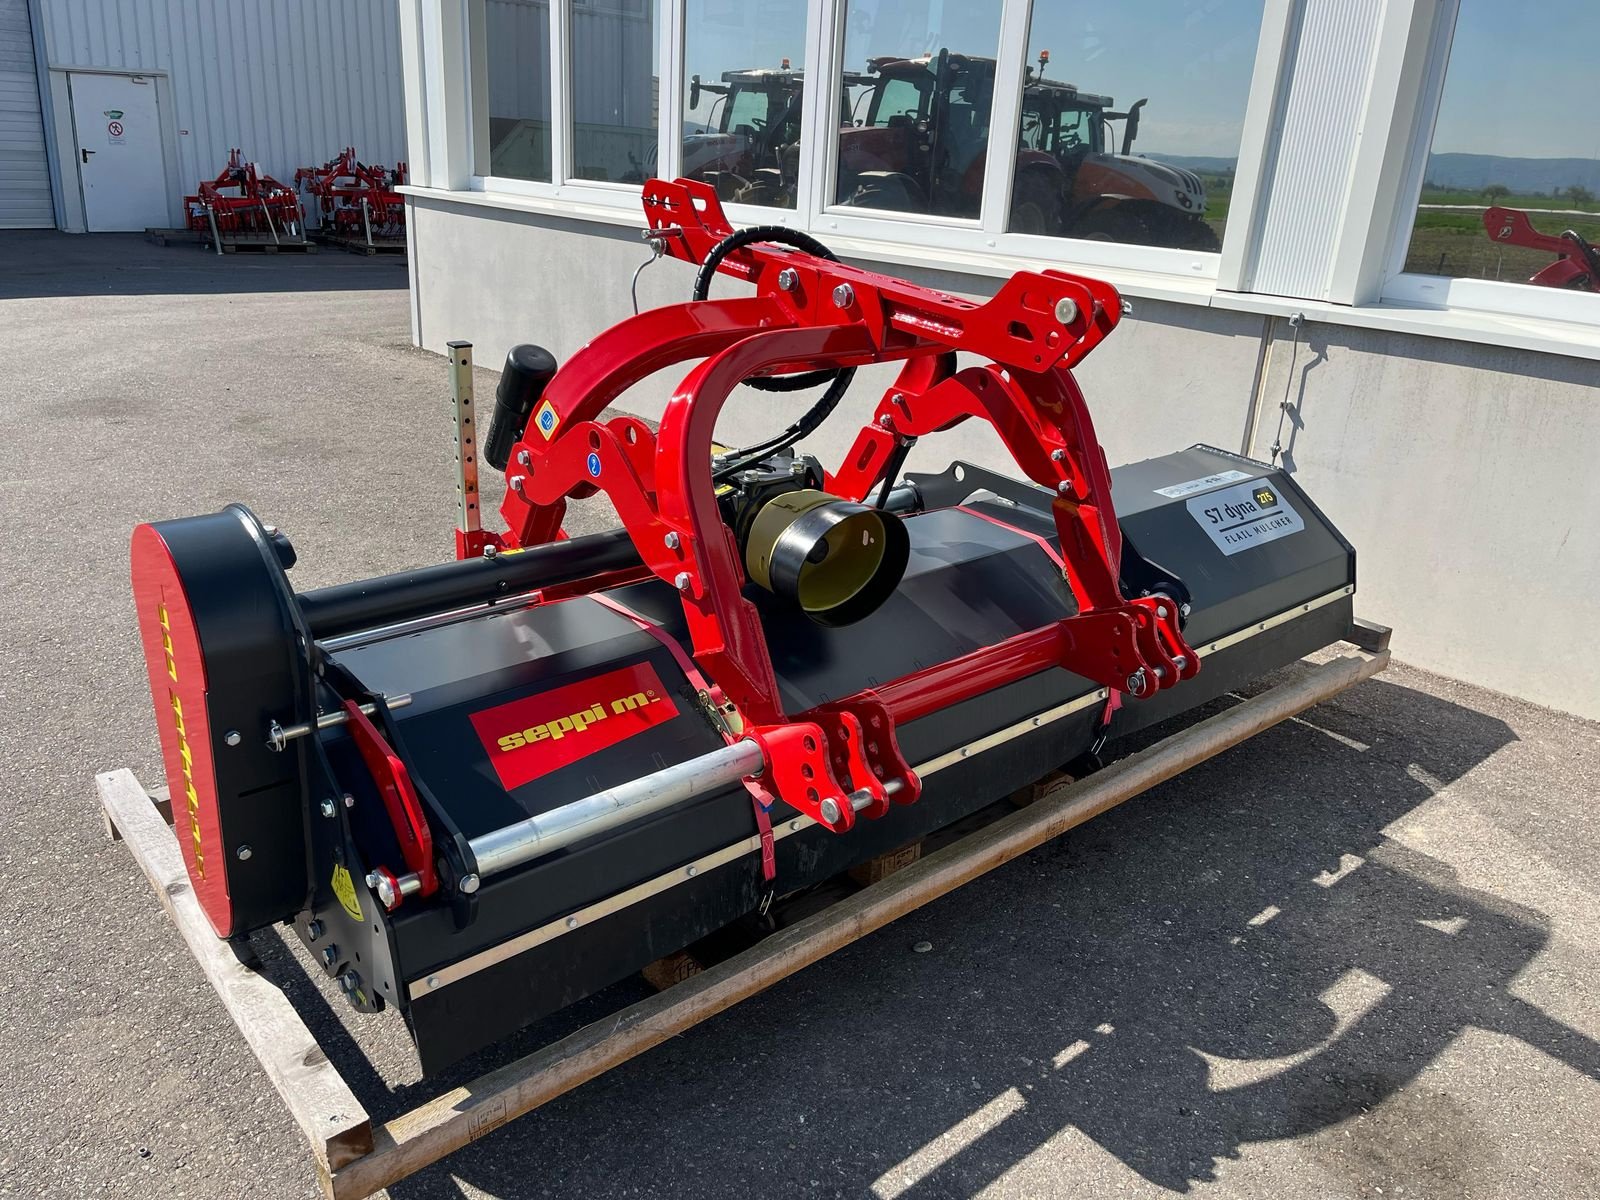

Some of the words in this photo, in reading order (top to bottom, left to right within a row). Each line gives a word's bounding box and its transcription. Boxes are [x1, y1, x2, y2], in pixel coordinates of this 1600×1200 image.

[1204, 507, 1224, 524] S7
[1224, 501, 1257, 520] dyna
[1256, 492, 1274, 504] 275
[1224, 529, 1253, 544] FLAIL
[1252, 516, 1293, 535] MULCHER
[497, 702, 608, 752] seppi
